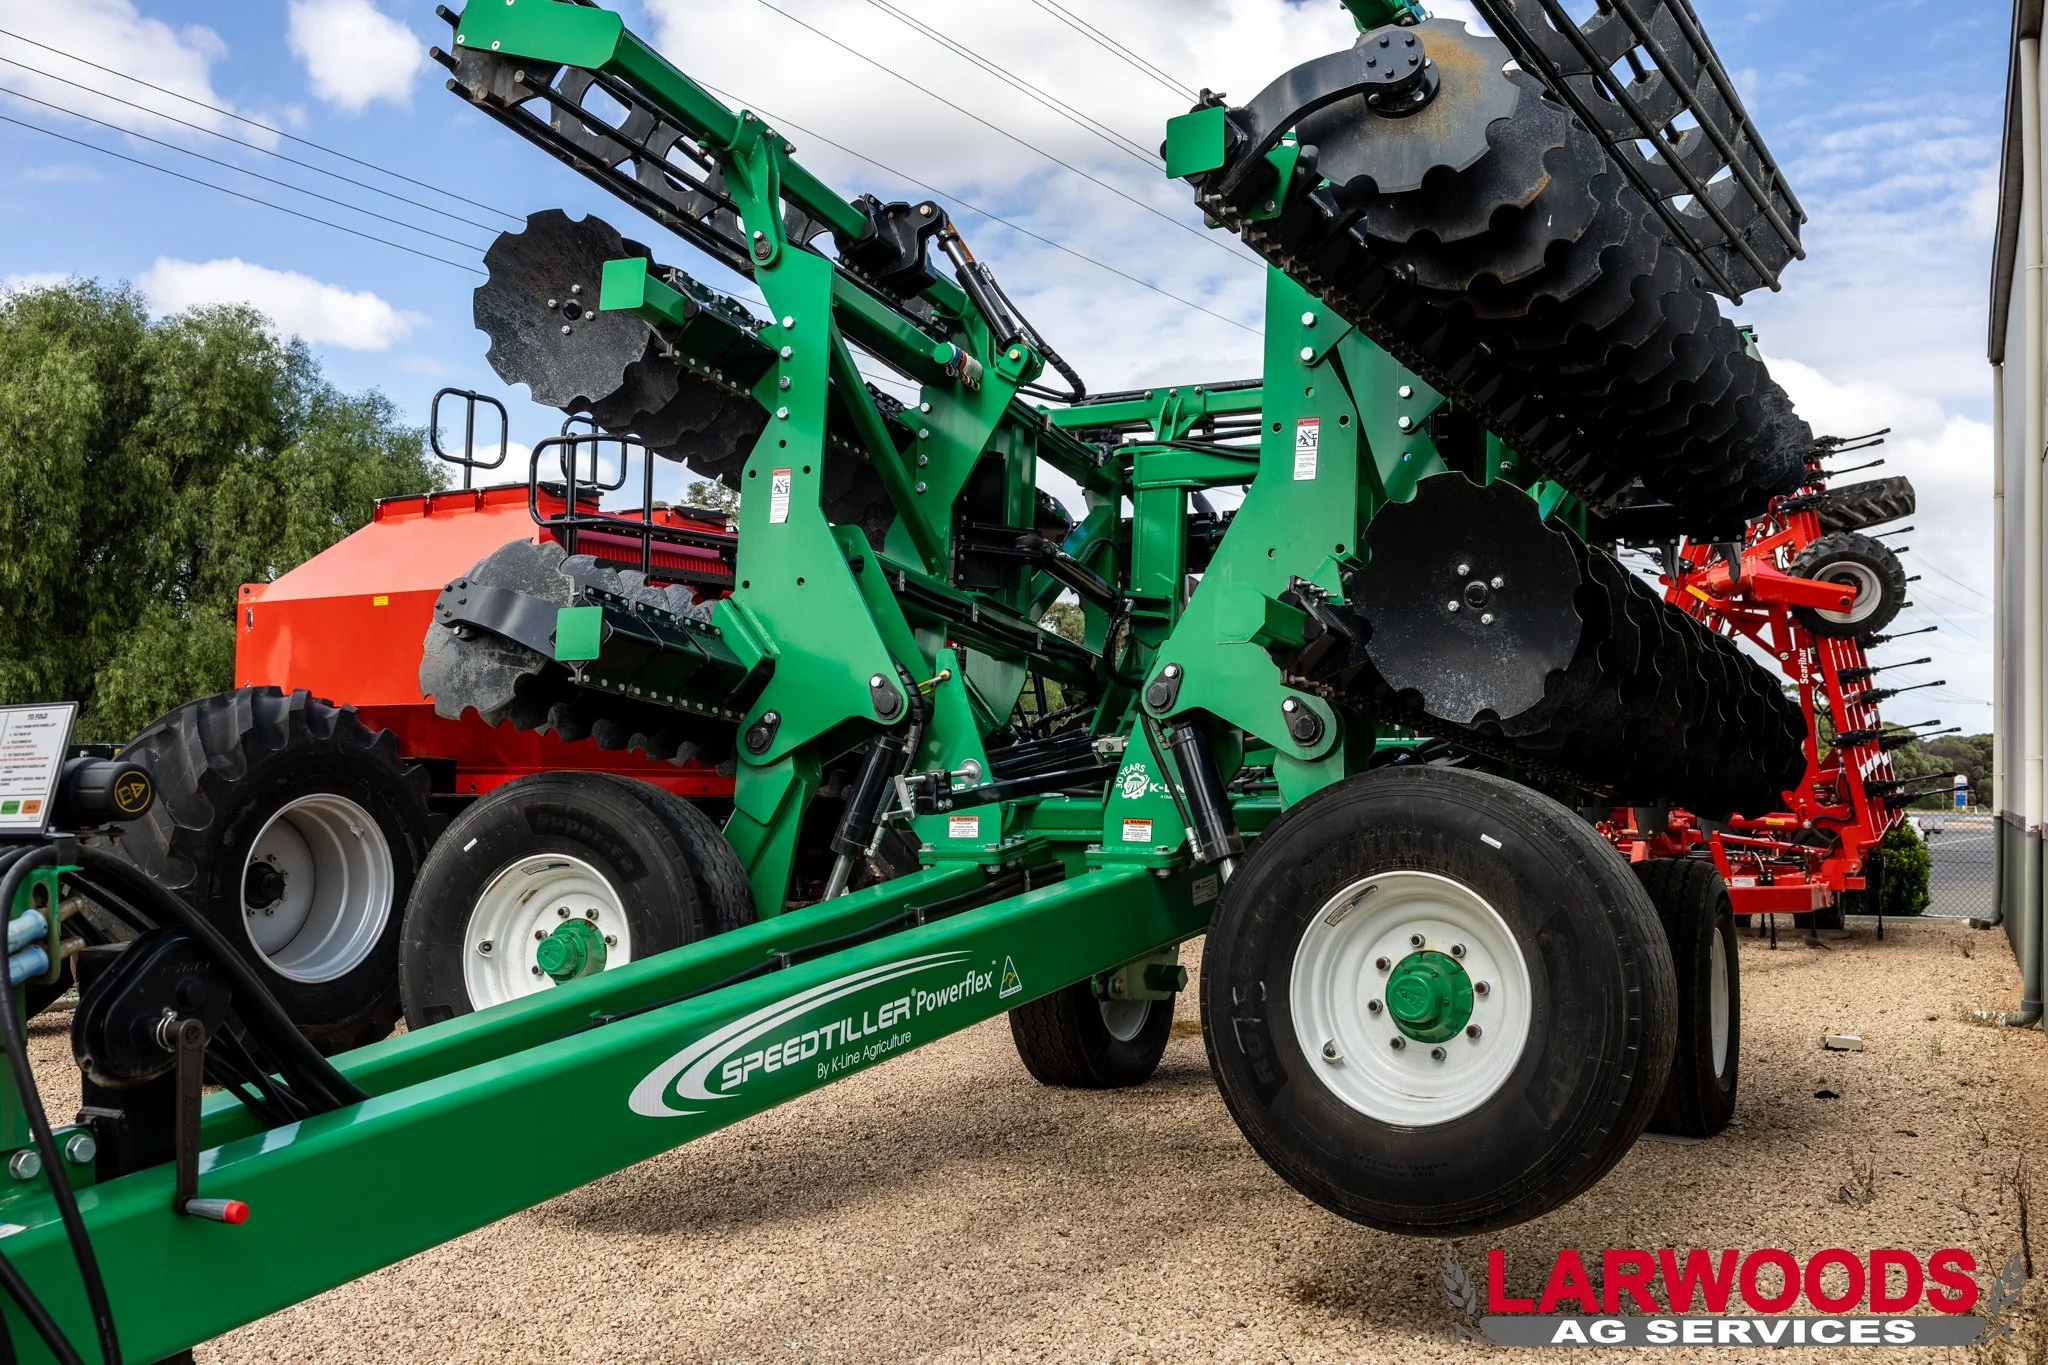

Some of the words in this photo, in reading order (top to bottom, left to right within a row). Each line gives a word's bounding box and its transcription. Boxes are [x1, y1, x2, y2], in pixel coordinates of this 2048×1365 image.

[1797, 647, 1809, 684] Scaribar
[1116, 776, 1123, 788] 30
[1120, 763, 1146, 777] YEARS
[817, 1062, 829, 1080] By
[831, 1052, 860, 1073] K-Line
[862, 1031, 911, 1061] Agriculture
